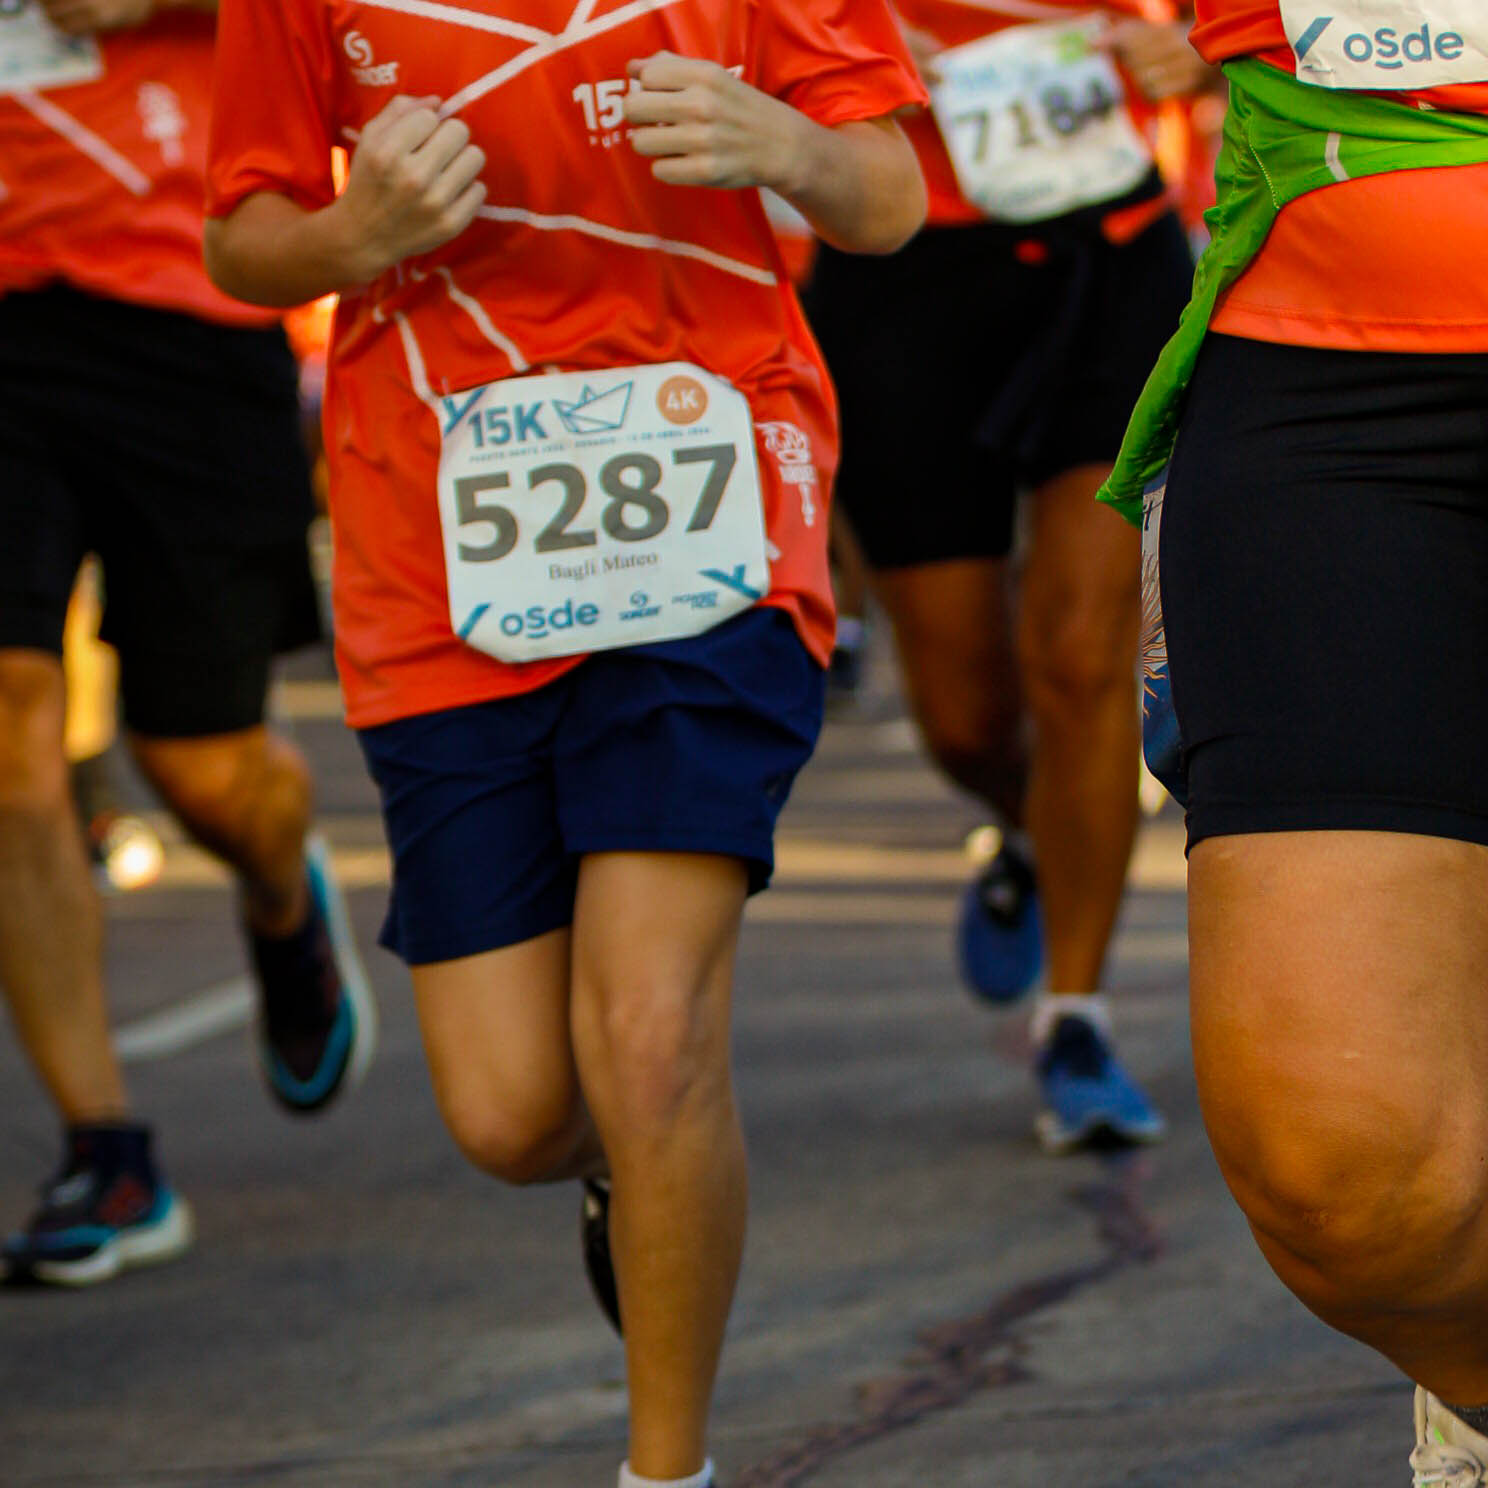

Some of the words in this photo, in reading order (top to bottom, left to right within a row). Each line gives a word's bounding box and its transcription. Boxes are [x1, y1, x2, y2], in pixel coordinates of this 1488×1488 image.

[1343, 23, 1464, 67] osde
[573, 78, 641, 131] 15
[666, 389, 699, 412] 4K
[467, 401, 548, 448] 15K
[453, 443, 738, 564] 5287
[500, 600, 600, 638] osde
